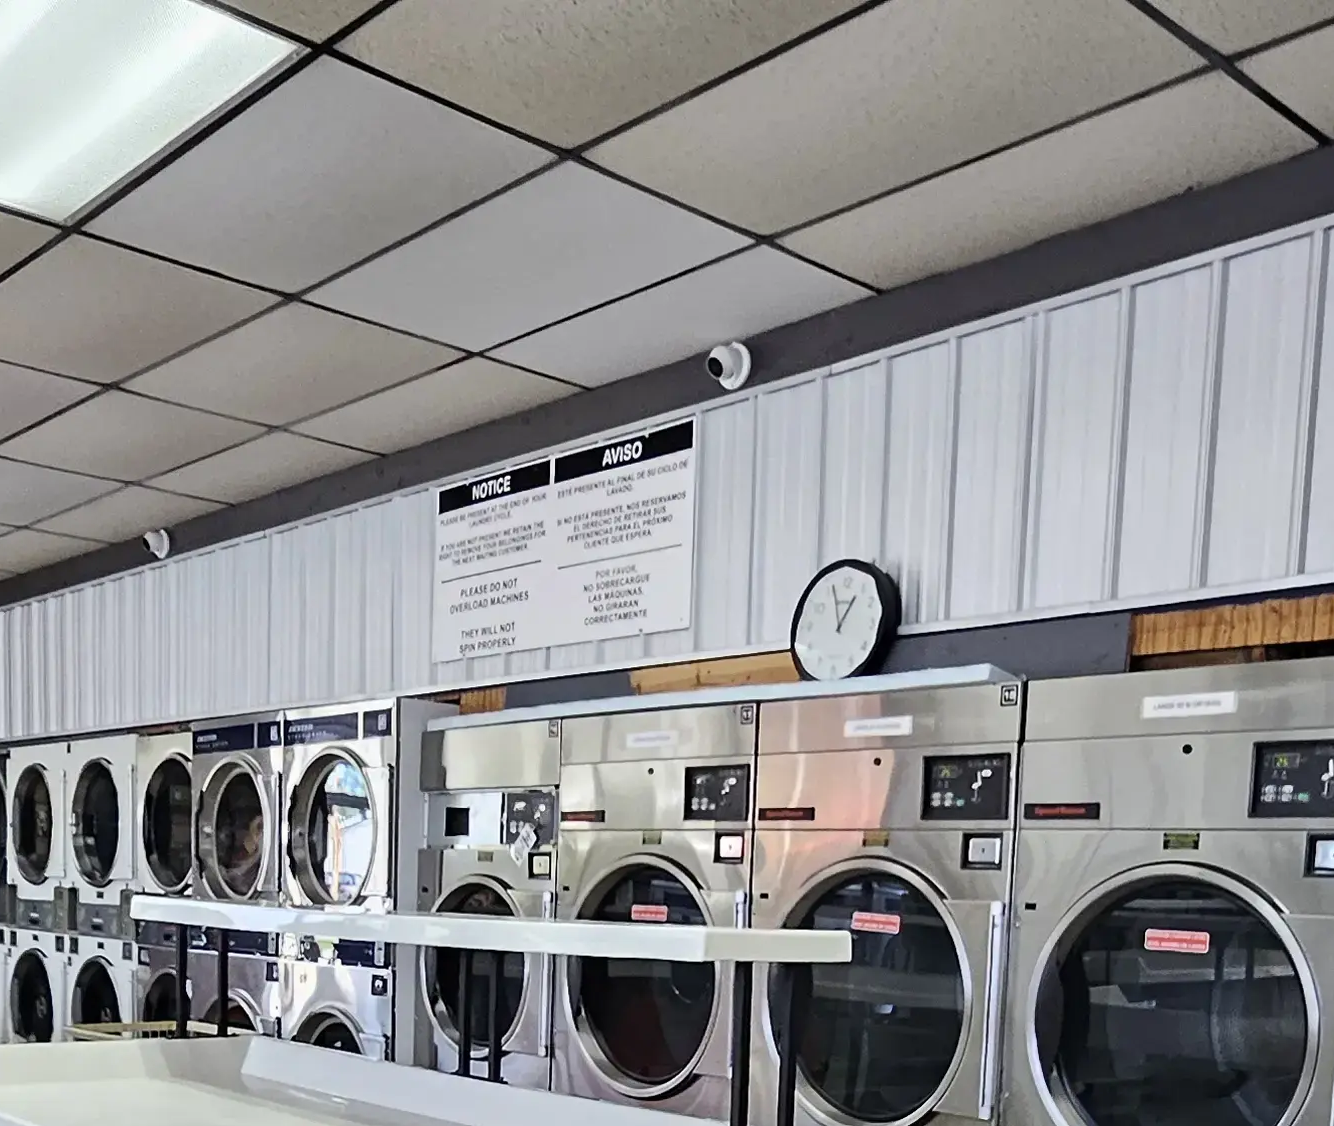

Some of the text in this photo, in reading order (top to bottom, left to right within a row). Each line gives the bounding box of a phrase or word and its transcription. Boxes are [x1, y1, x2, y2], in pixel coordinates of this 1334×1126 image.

[602, 441, 642, 467] AVISO
[574, 481, 605, 494] PRESENTE
[617, 474, 636, 484] FINAL
[637, 471, 645, 479] DE
[647, 468, 656, 476] SU
[657, 463, 678, 474] CICLO
[679, 459, 688, 469] DE
[472, 475, 511, 500] NOTICE
[440, 516, 458, 526] PLEASE
[467, 508, 489, 518] PRESENT
[564, 516, 572, 524] NO
[627, 501, 640, 510] NOS
[641, 491, 687, 507] RESERVAMOS
[573, 506, 666, 532] EL DERECHO DE RETIRAR SUS
[567, 526, 613, 543] PERTENENCIAS
[615, 522, 631, 533] PARA
[633, 520, 640, 529] EL
[584, 537, 609, 549] CLIENTE
[611, 533, 624, 544] QUE
[461, 545, 481, 555] REMOVE
[498, 533, 532, 546] BELONGINGS
[583, 573, 650, 593] NO SOBRECARGUE
[595, 569, 610, 579] POR
[460, 578, 517, 598] PLEASE DO NOT
[450, 590, 529, 615] OVERLOAD MACHINES
[588, 594, 602, 604] LAS
[584, 609, 647, 626] CORRECTAMENTE
[461, 621, 515, 639] THEY WILL NOT
[459, 637, 516, 653] SPIN PROPERLY
